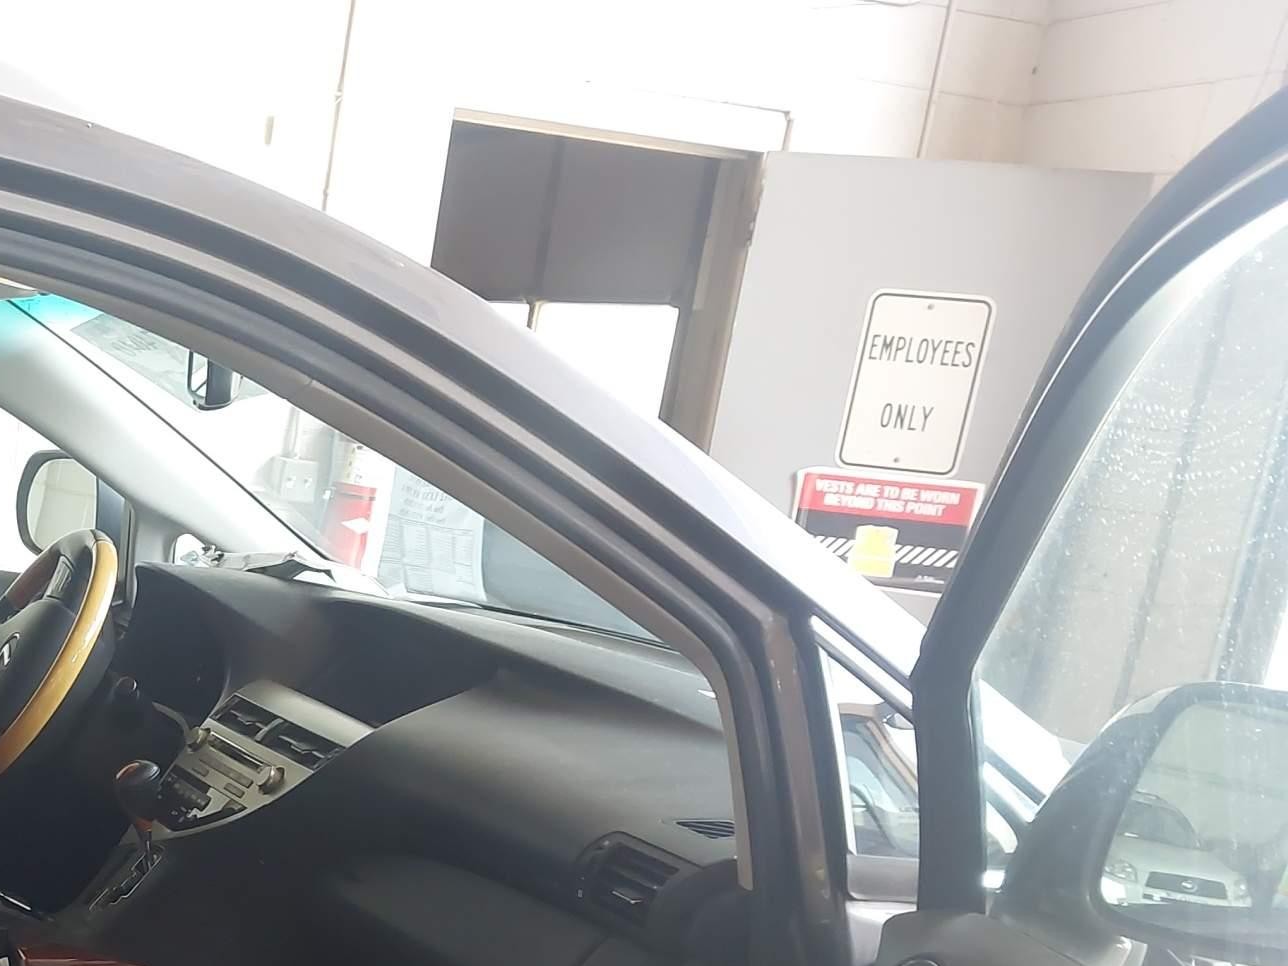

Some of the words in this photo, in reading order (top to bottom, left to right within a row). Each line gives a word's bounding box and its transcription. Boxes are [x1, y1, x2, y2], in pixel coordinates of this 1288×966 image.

[868, 334, 975, 368] EMPLOYEES
[880, 403, 934, 432] ONLY
[815, 479, 855, 495] VESTS
[855, 483, 880, 498] ARE
[883, 485, 900, 499] TO
[900, 488, 918, 501] BE
[919, 489, 961, 505] WORN
[823, 493, 875, 510] BEYOND
[876, 498, 905, 513] THIS
[905, 502, 947, 517] POINT
